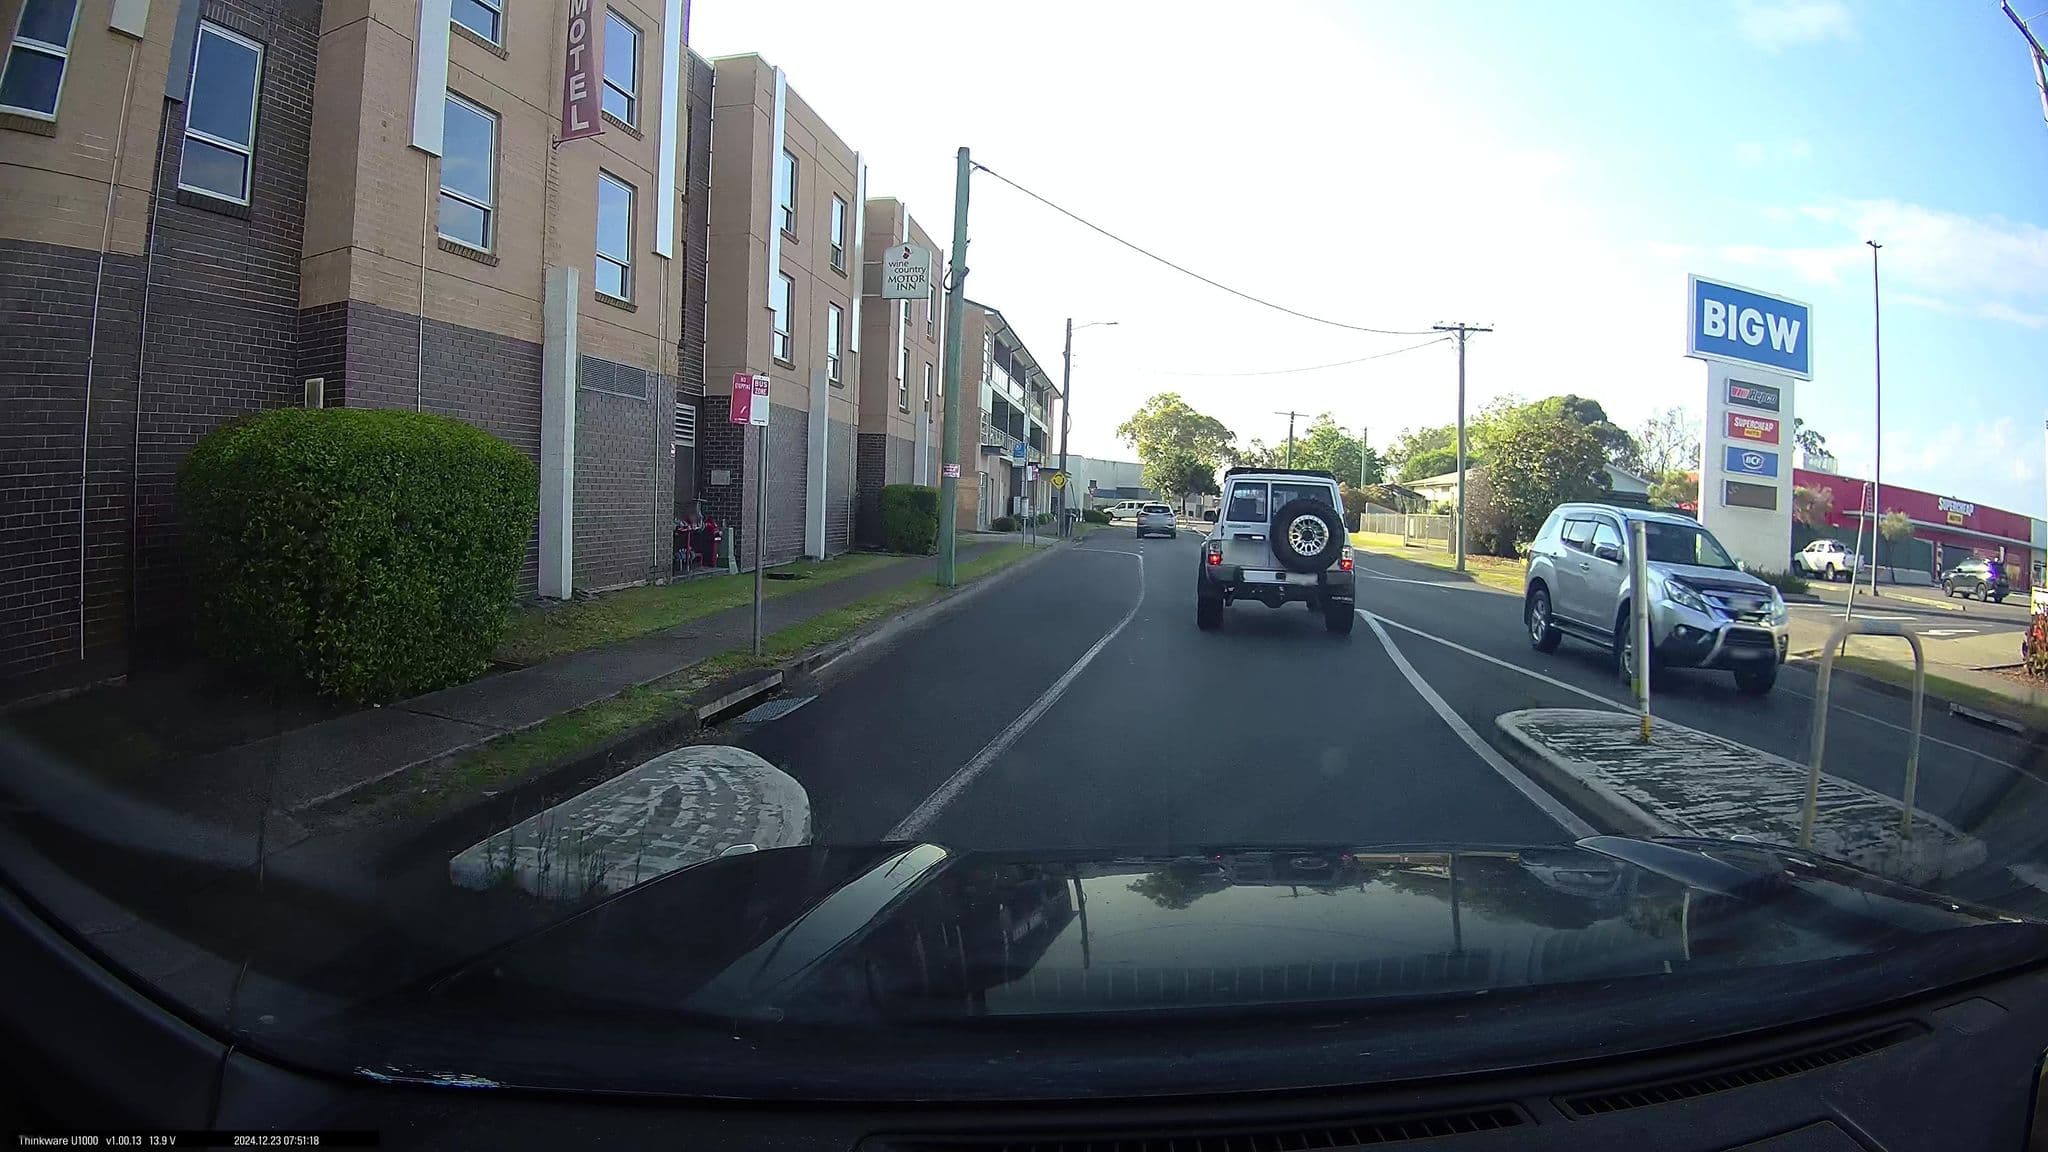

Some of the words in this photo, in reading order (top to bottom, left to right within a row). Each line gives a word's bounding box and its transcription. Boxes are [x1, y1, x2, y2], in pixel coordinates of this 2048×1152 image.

[569, 0, 589, 131] MOTEL
[894, 266, 927, 274] country
[887, 275, 926, 283] MOTOR
[896, 283, 917, 291] INN
[754, 380, 768, 388] BUS
[1748, 389, 1778, 405] Repco
[1733, 416, 1775, 433] SUPERCHEAP
